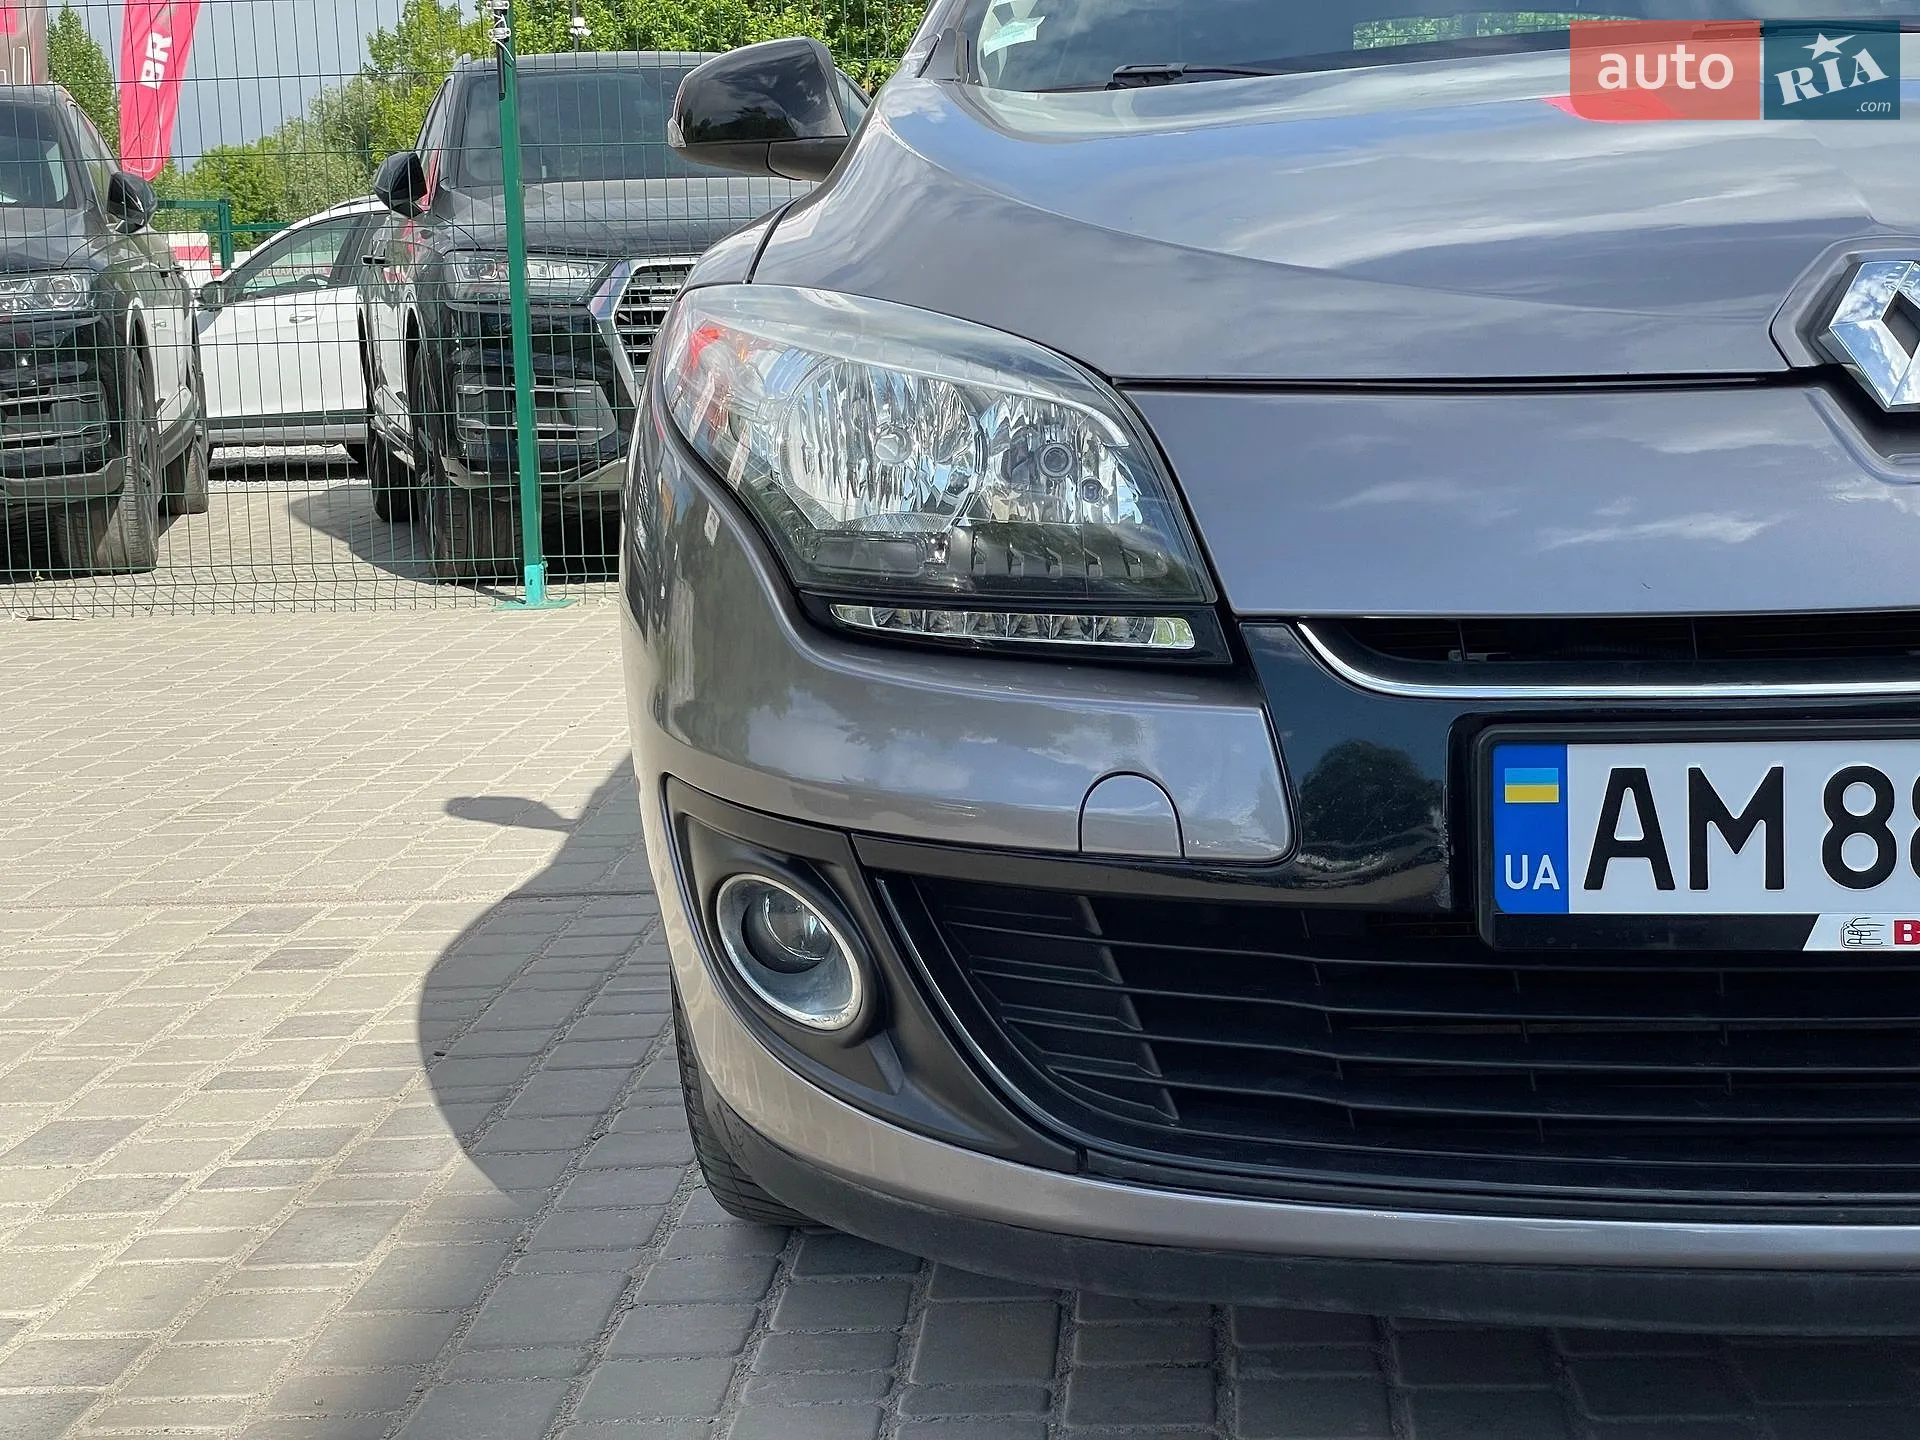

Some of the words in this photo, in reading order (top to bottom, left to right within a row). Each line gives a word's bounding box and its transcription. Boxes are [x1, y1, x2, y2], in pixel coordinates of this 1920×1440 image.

[1583, 766, 1785, 890] AM
[1821, 765, 1920, 890] 8
[1504, 854, 1560, 890] UA
